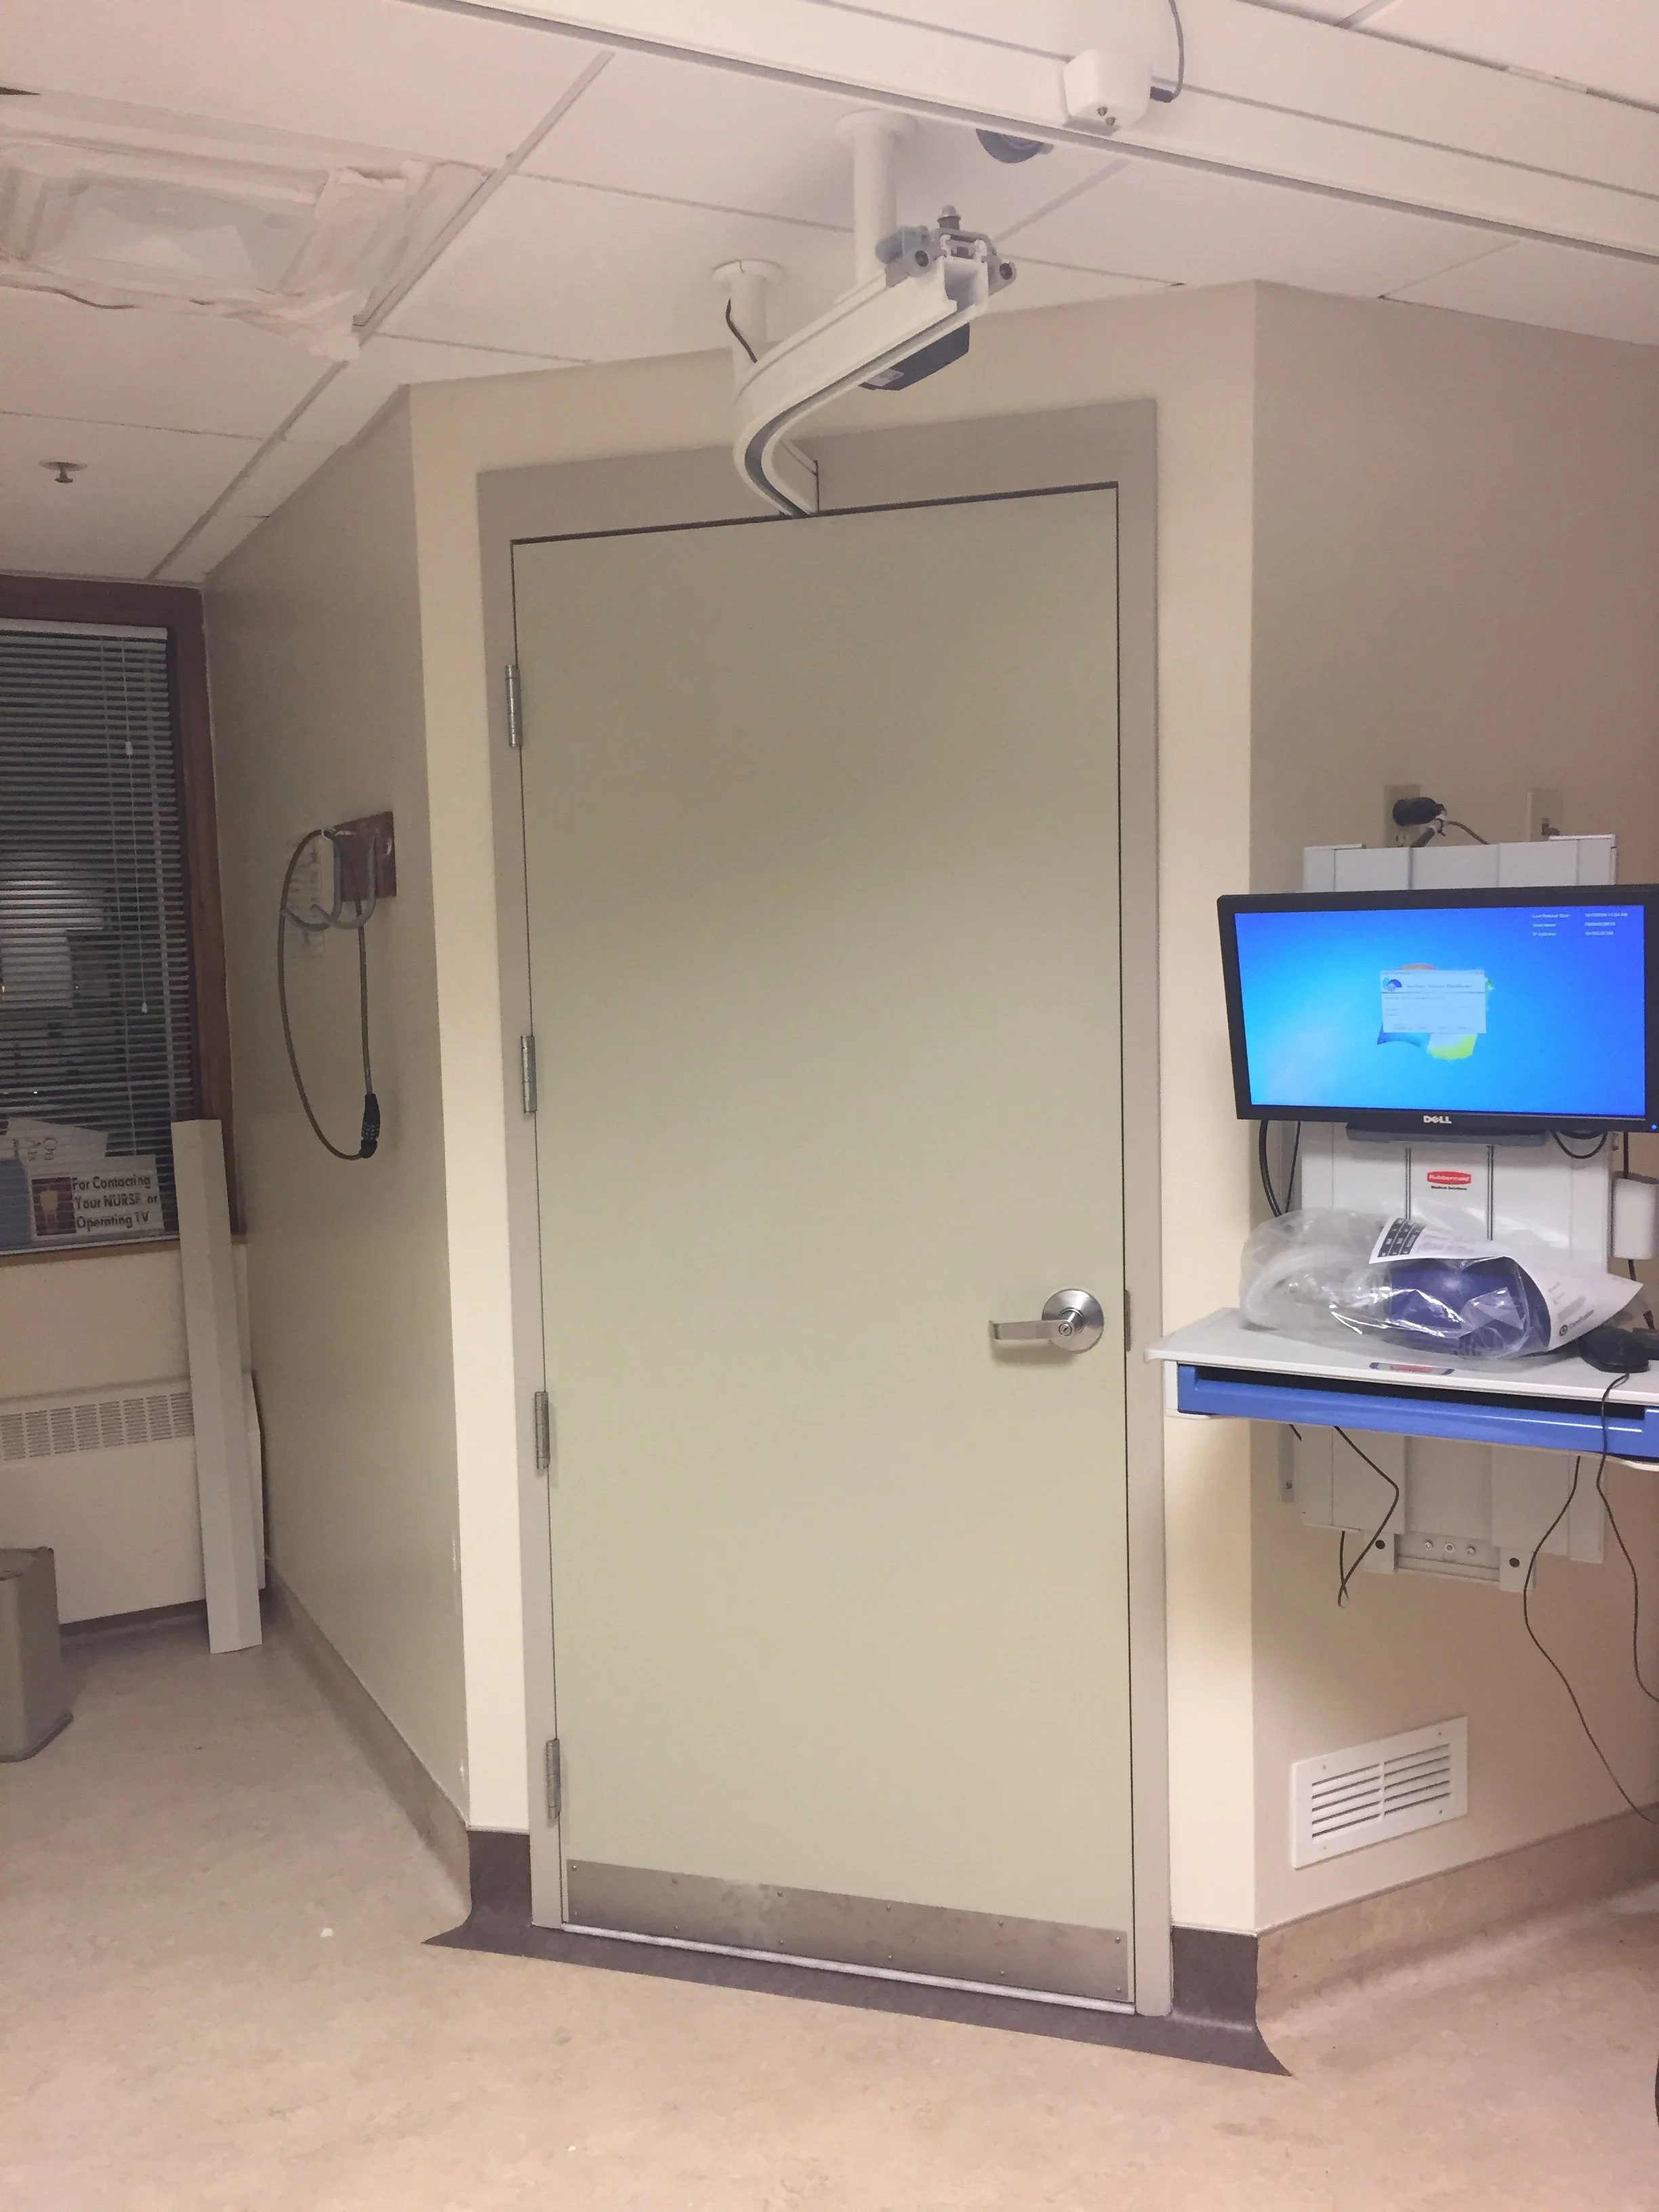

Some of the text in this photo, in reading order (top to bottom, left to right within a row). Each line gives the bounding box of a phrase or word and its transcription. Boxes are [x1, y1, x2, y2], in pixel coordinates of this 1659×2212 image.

[1423, 1115, 1452, 1124] DELL
[72, 1174, 150, 1190] For Contacting
[75, 1192, 157, 1210] Your NURSE or
[77, 1210, 148, 1232] Operating TV
